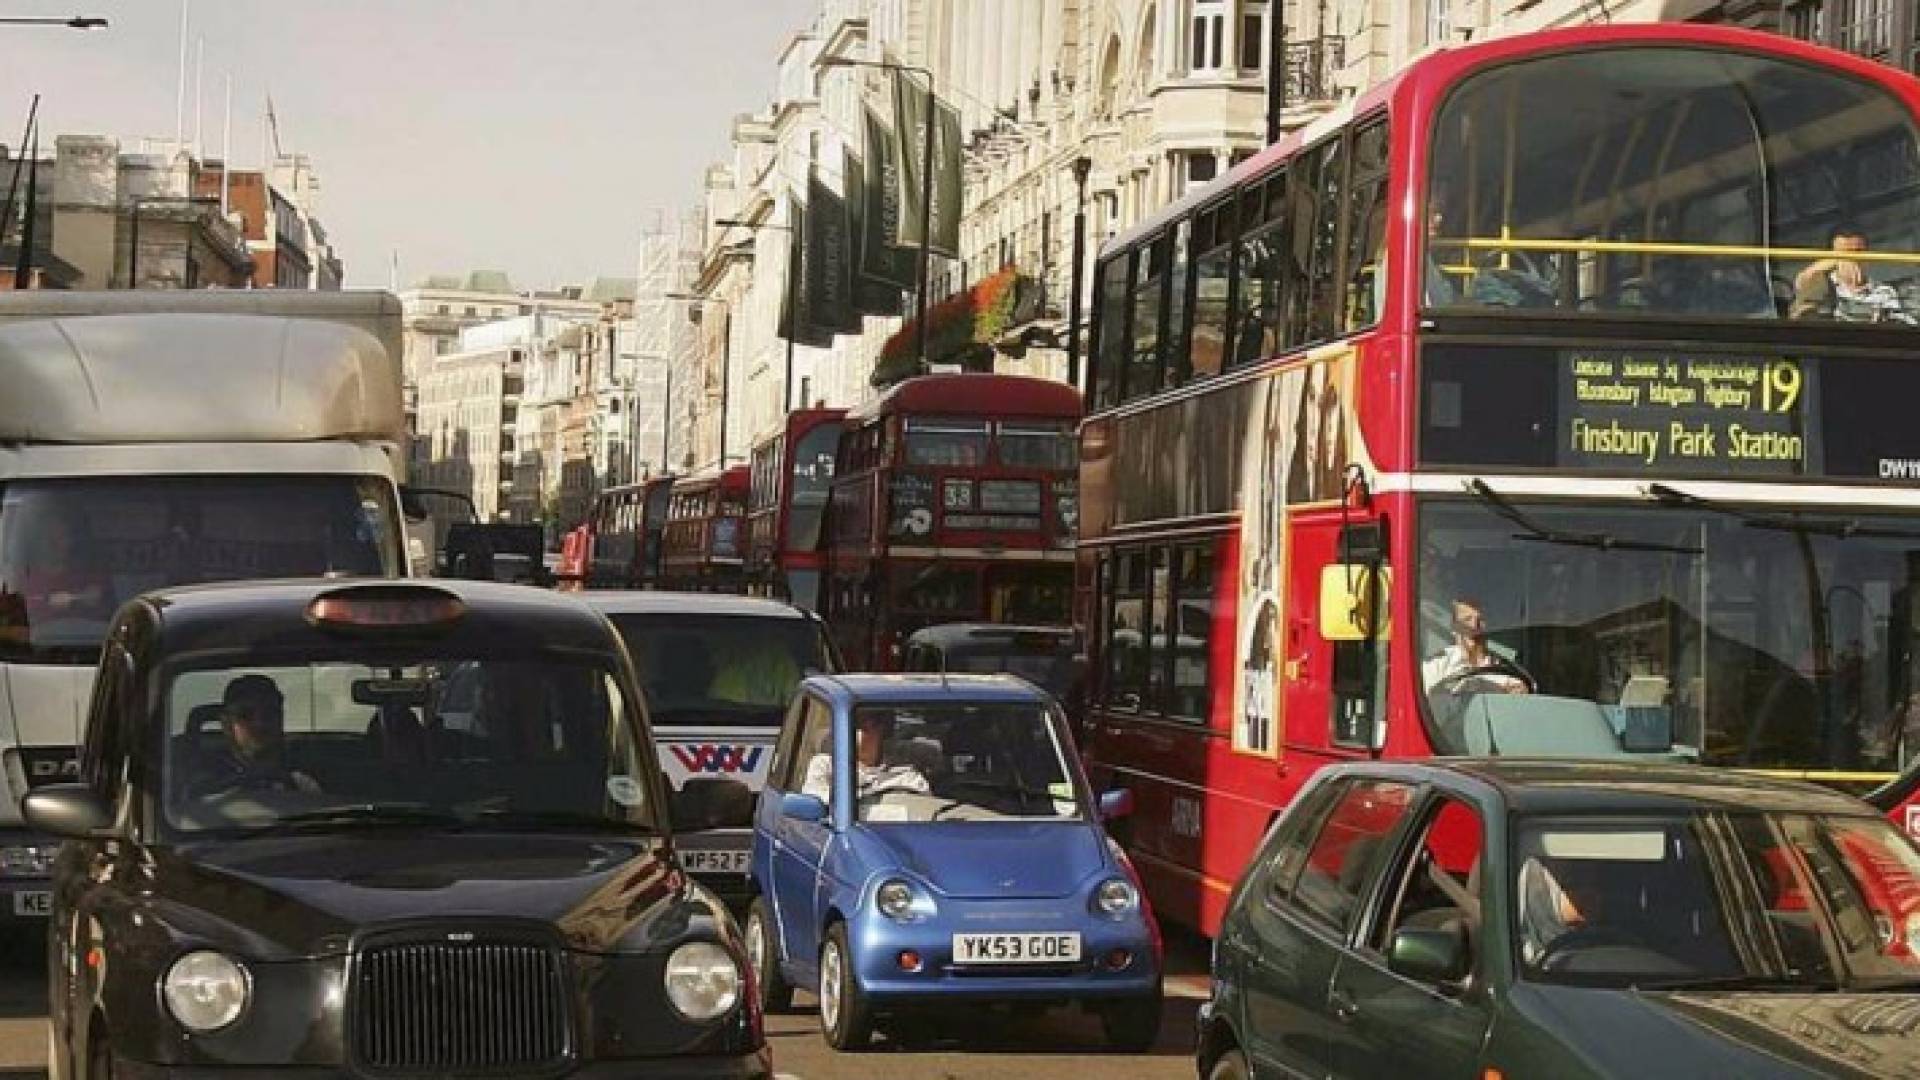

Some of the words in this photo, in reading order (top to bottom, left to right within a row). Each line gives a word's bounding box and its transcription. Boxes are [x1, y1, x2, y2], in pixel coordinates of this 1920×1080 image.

[1762, 361, 1801, 412] 19
[1571, 417, 1659, 465] Finsbury
[1669, 420, 1716, 457] Park
[1727, 423, 1802, 460] Station
[734, 852, 751, 870] F
[963, 936, 1022, 959] YK53
[1028, 936, 1073, 959] GOE
